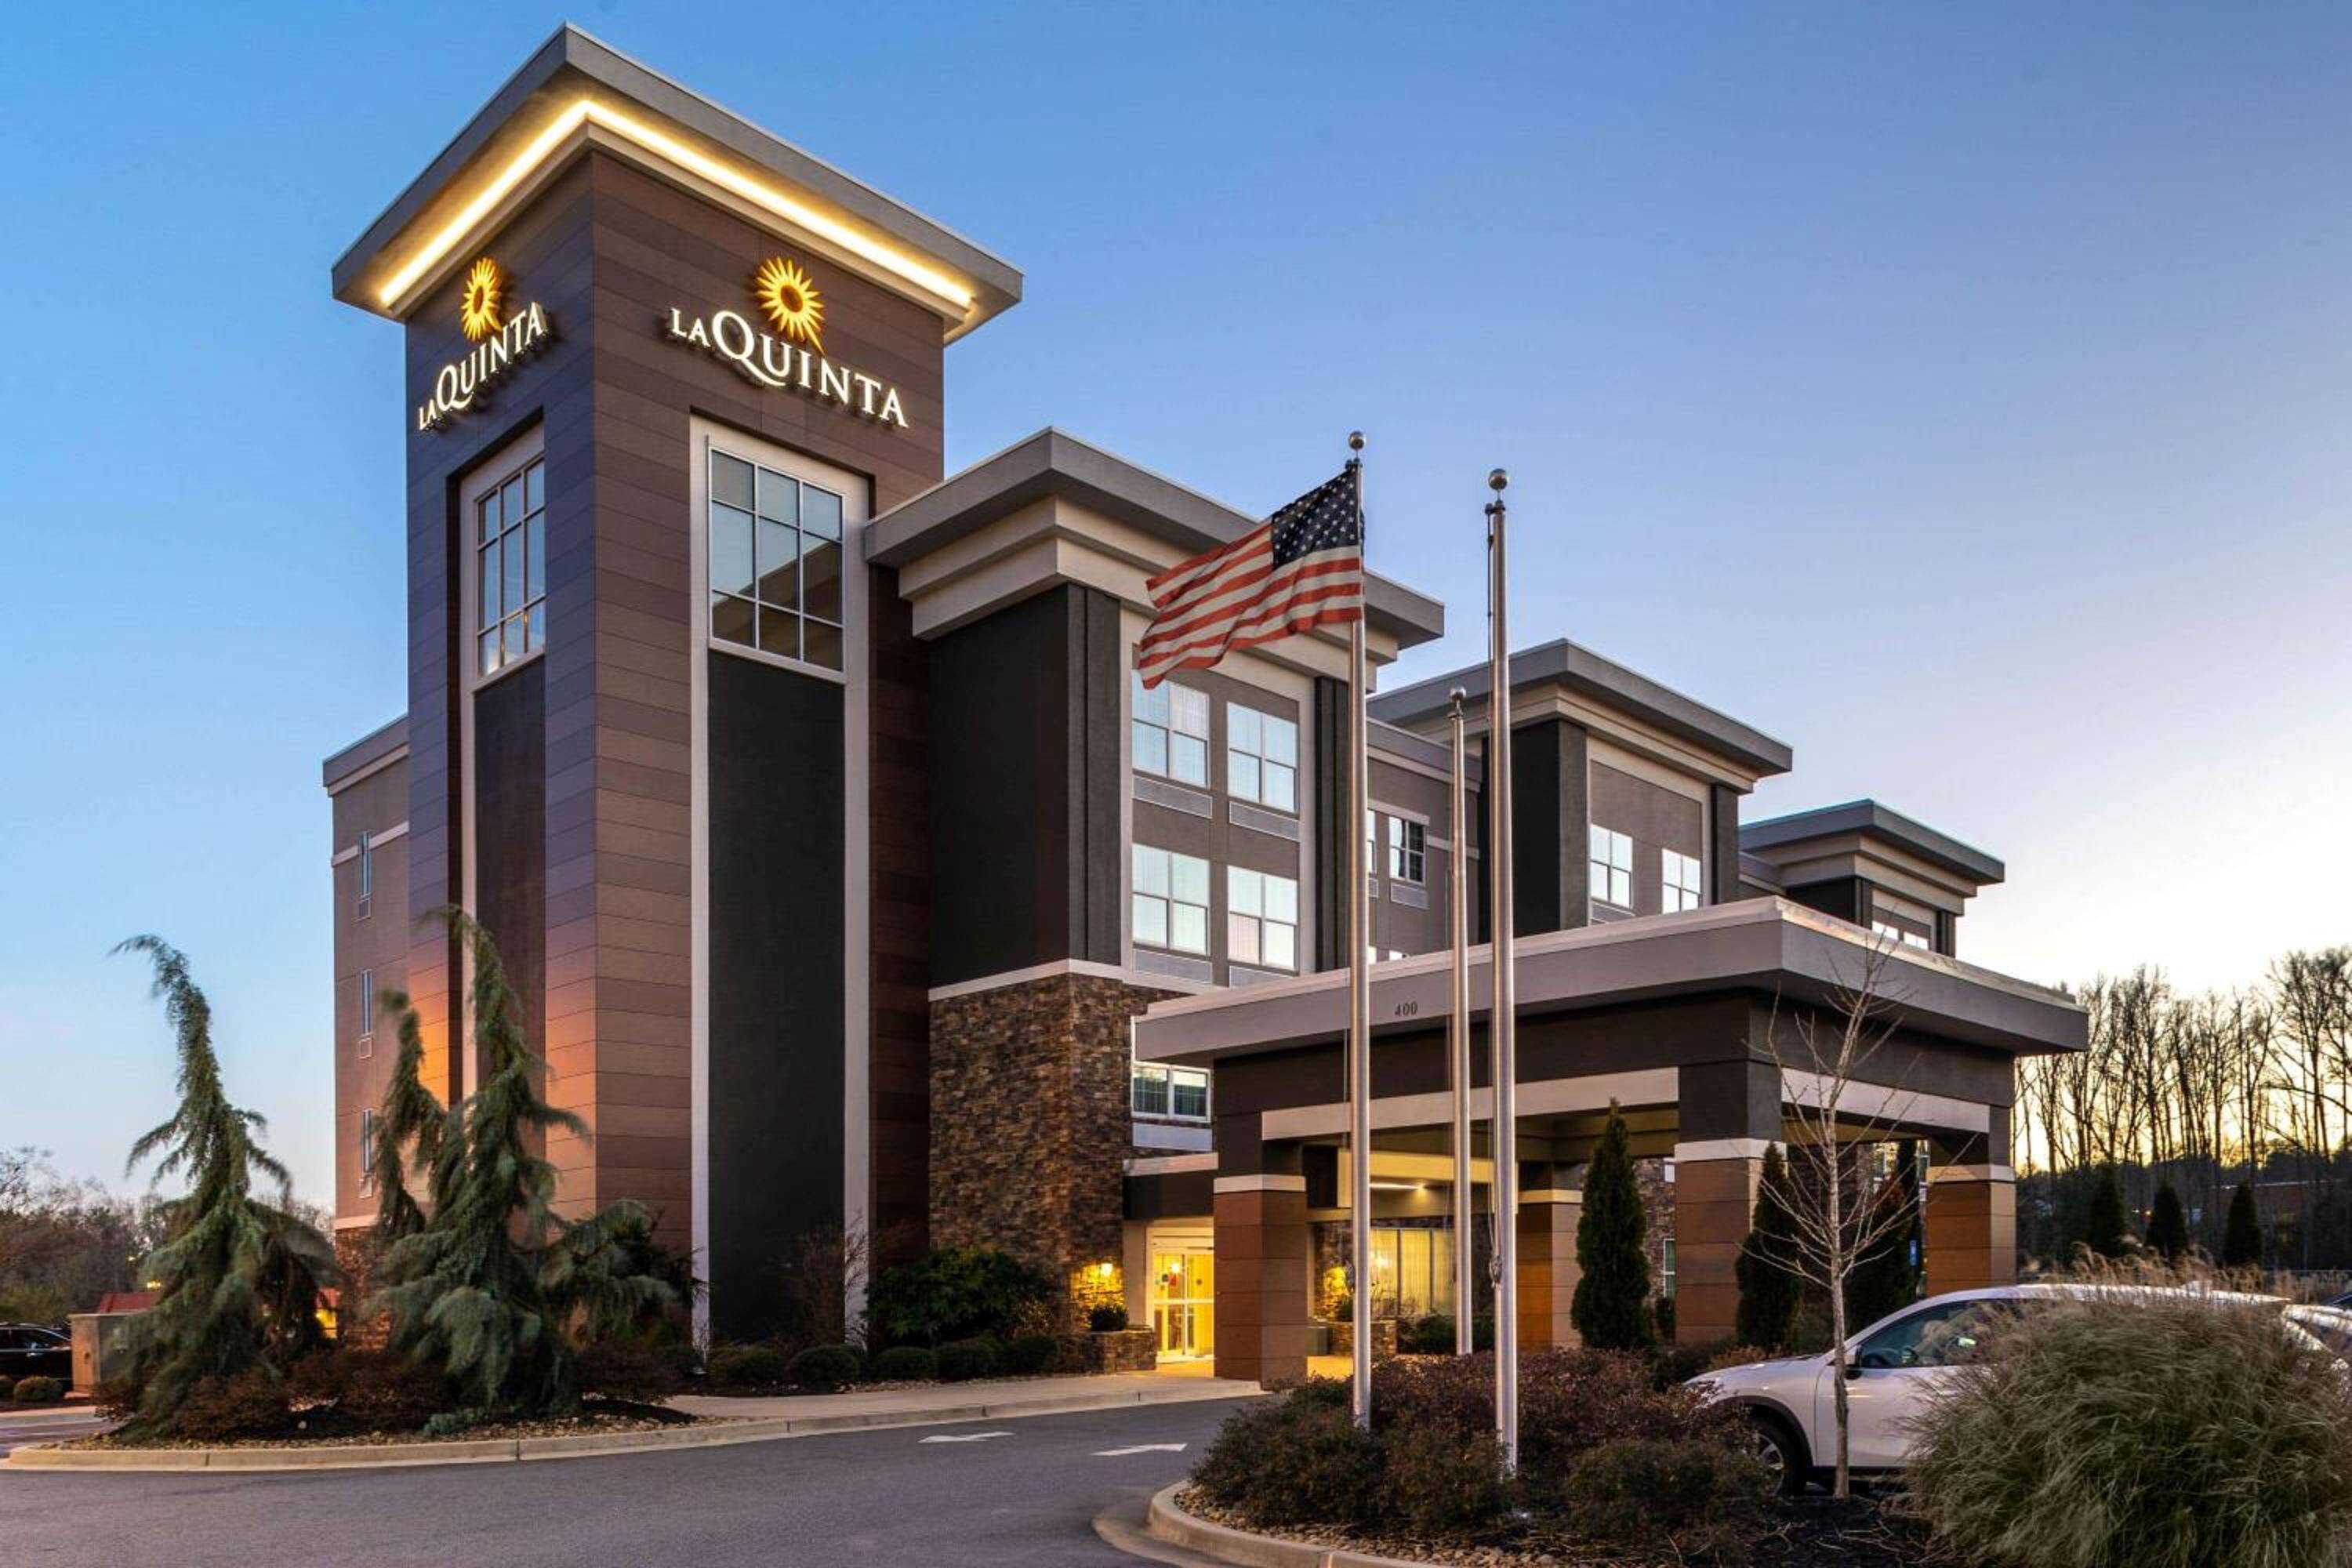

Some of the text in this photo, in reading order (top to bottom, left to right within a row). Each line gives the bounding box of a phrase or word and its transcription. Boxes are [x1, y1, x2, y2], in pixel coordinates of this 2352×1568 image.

[419, 302, 546, 430] LA QUINTA
[669, 307, 909, 428] LA QUINTA
[1395, 1001, 1418, 1017] 400
